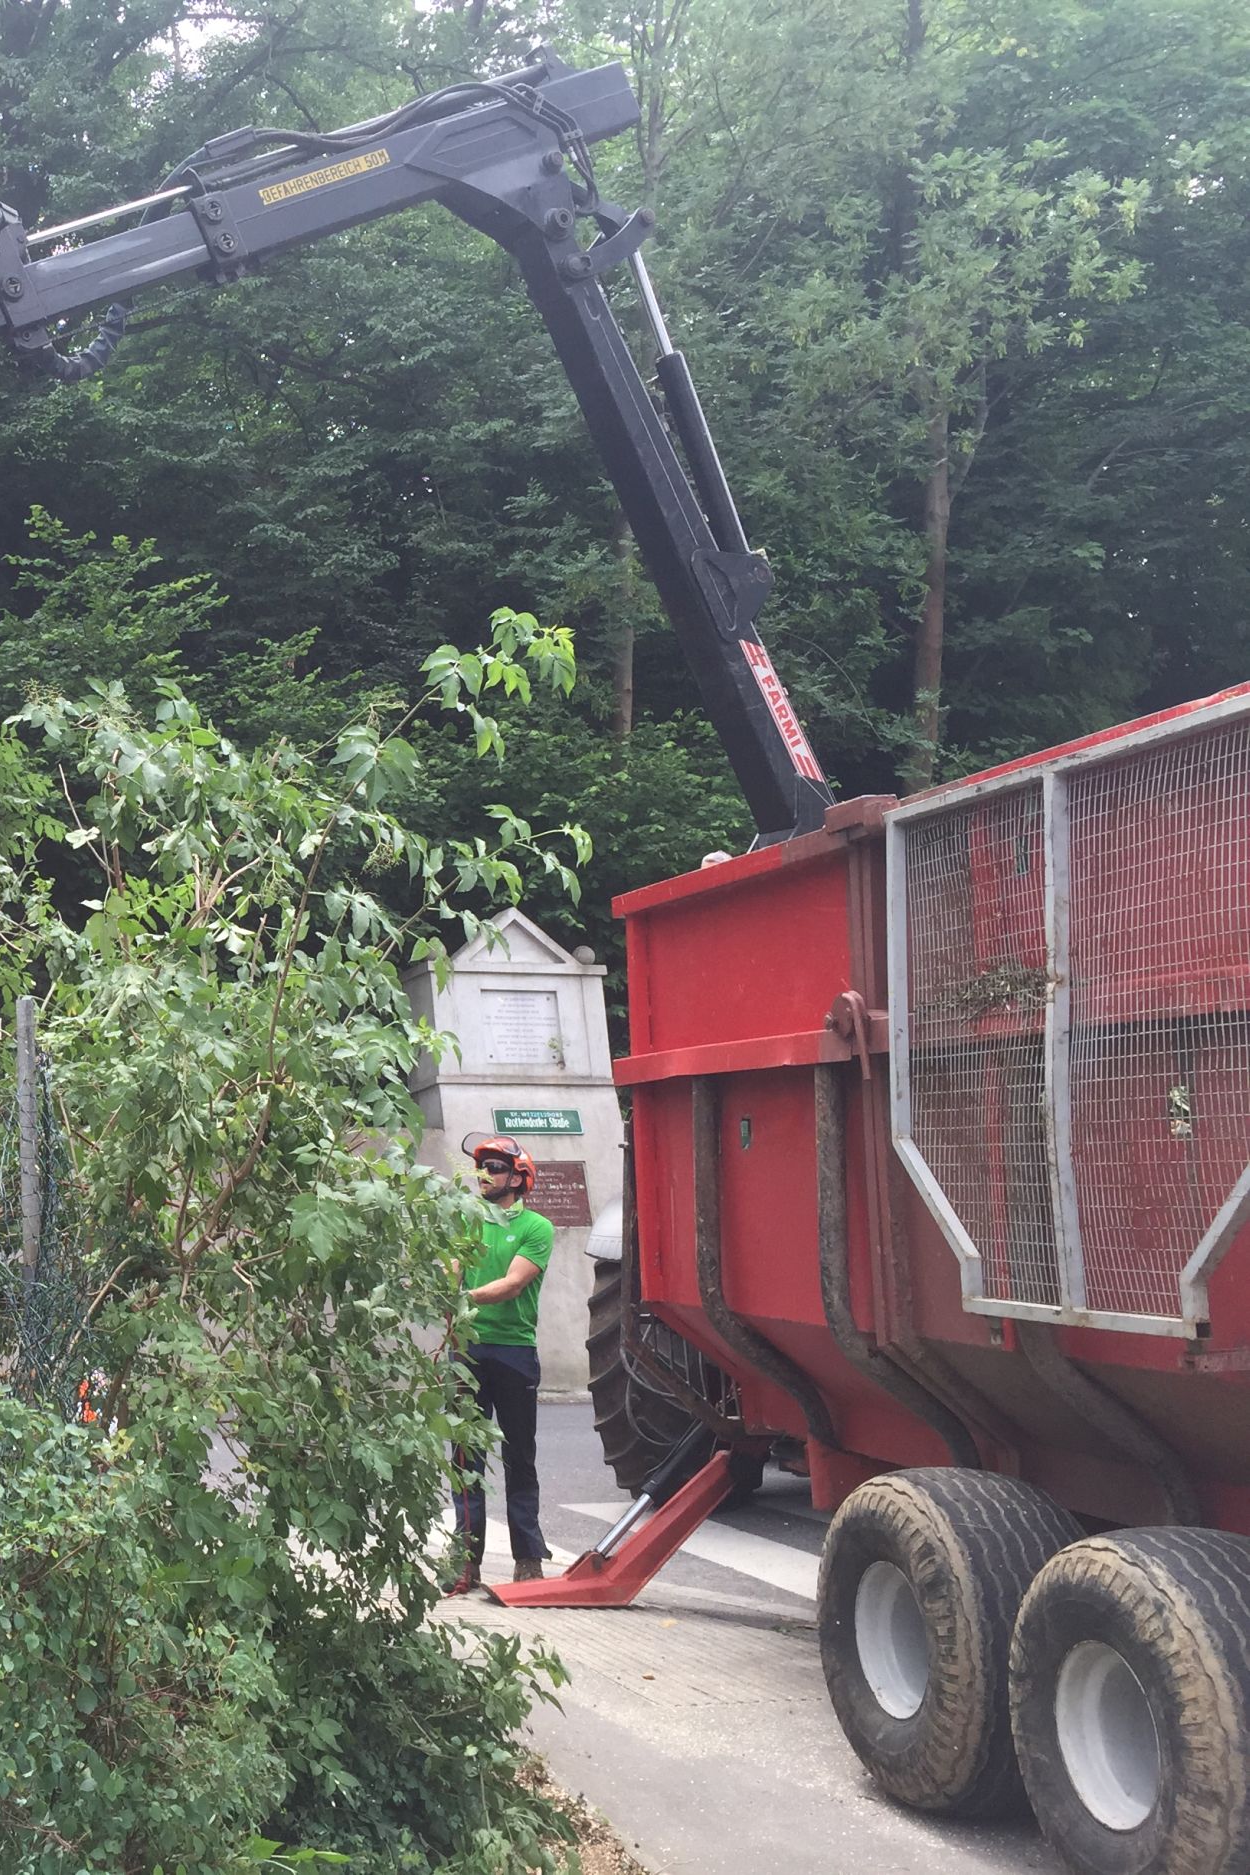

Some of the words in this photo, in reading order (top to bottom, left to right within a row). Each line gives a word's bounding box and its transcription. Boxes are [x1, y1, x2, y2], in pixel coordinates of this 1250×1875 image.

[261, 159, 362, 203] GEFAHRENBEREICH
[762, 674, 802, 748] FARMI
[504, 1117, 548, 1128] Krottendorfer
[548, 1117, 570, 1128] Straße
